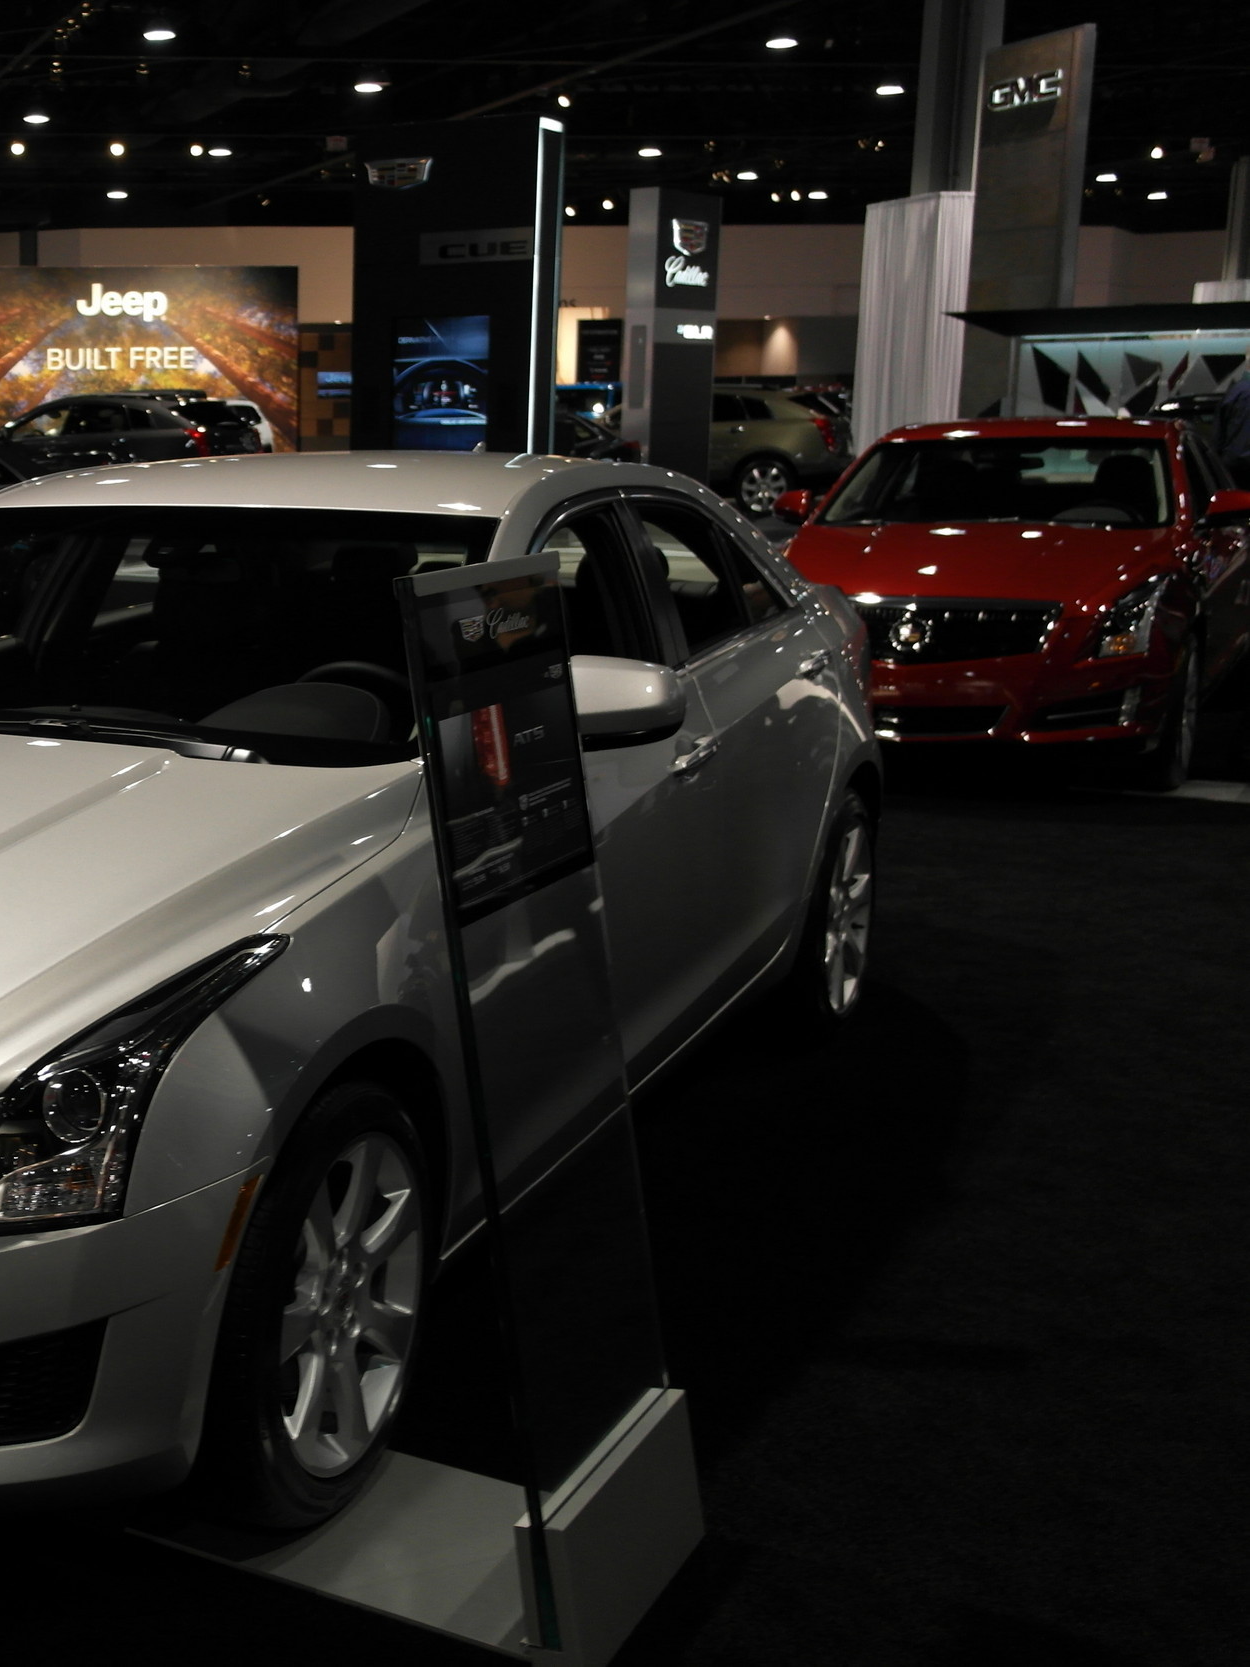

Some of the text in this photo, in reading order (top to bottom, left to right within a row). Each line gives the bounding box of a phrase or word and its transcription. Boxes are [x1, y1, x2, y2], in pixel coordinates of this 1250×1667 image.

[987, 68, 1064, 112] GMC
[438, 240, 528, 259] CUE
[76, 283, 168, 322] Jeep
[46, 346, 194, 371] BUILT FREE
[486, 607, 530, 640] Cadillac
[514, 725, 545, 747] ATS
